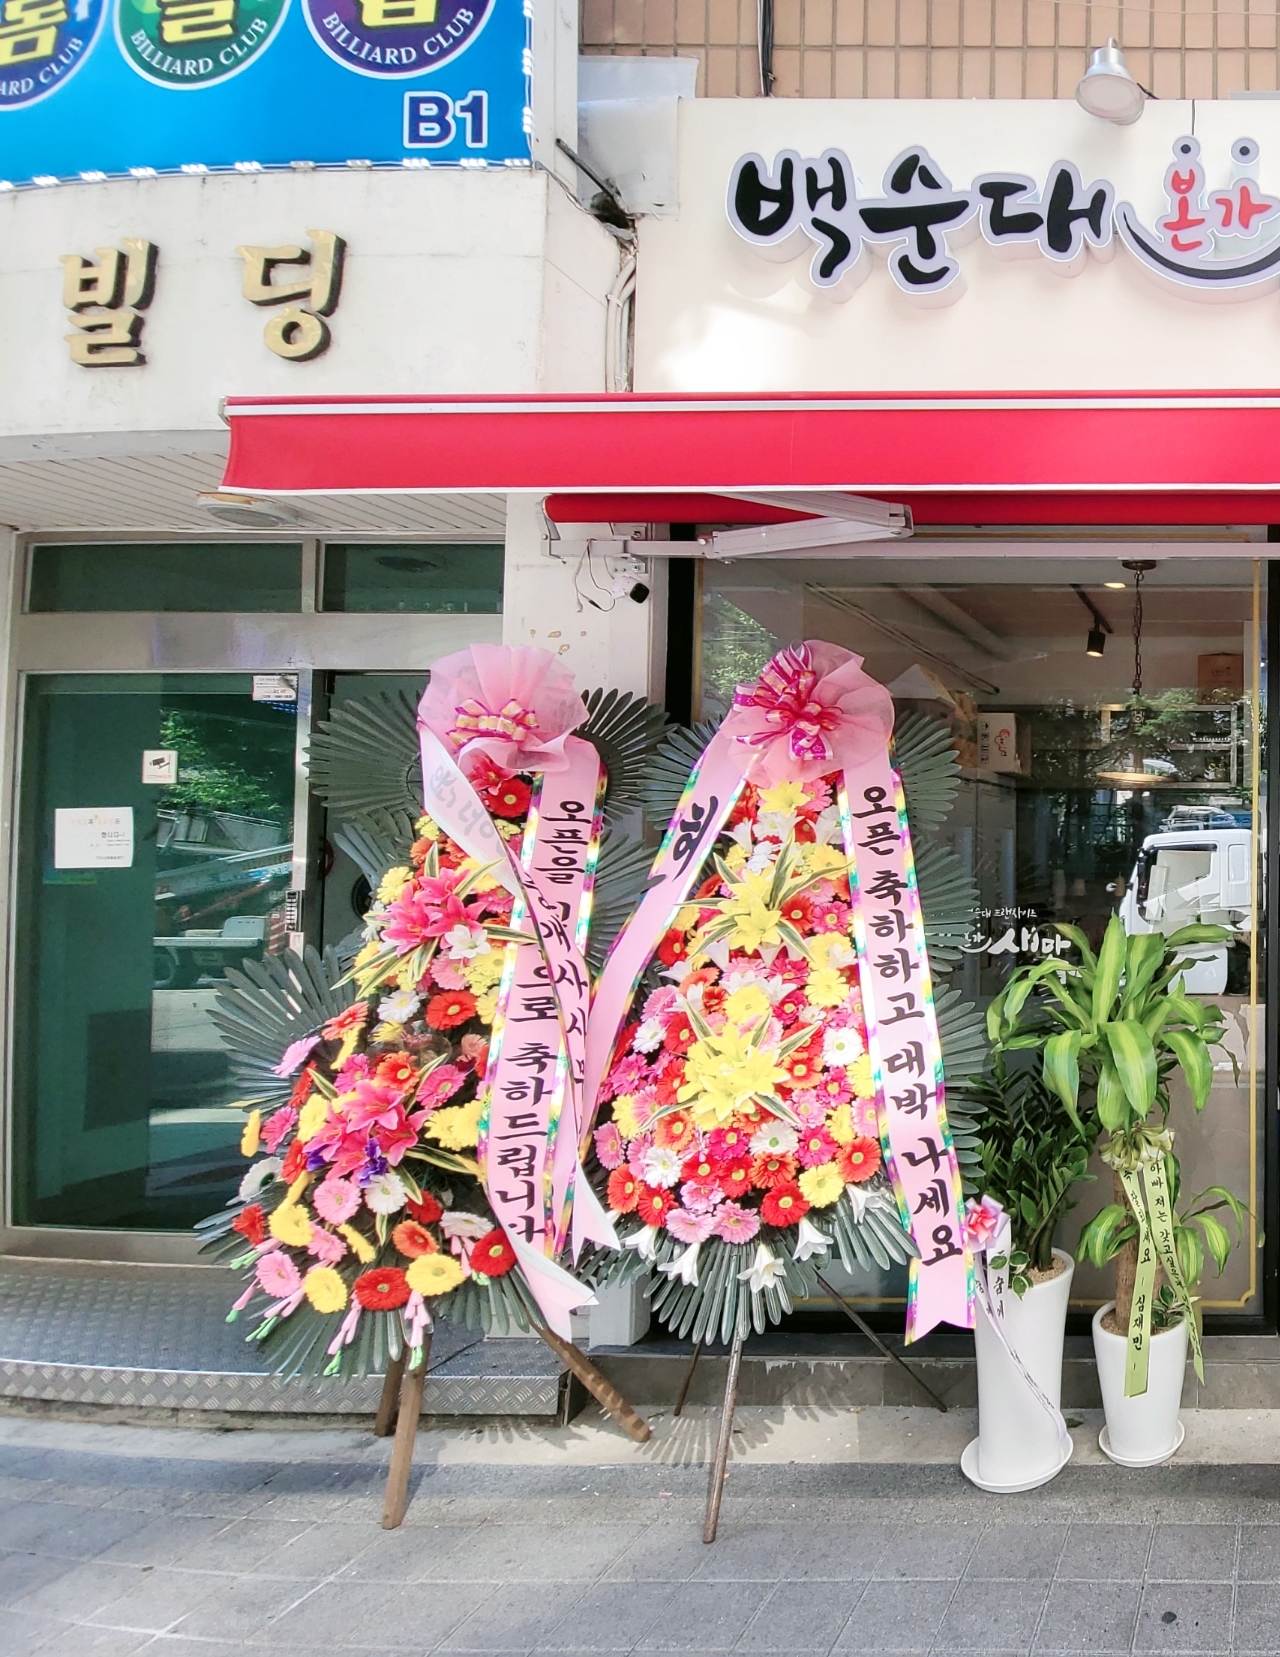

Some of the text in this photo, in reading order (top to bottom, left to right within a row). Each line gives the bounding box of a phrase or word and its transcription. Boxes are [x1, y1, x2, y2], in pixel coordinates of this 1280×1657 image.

[39, 37, 83, 84] CLUB
[131, 28, 213, 75] BILLIARD
[219, 18, 268, 65] CLUB
[322, 11, 416, 64] BILLIARD
[423, 8, 474, 55] CLUB
[404, 91, 487, 147] B1
[736, 152, 1106, 285] 백순대
[1162, 168, 1273, 253] 본가
[534, 800, 592, 885] 오픈을
[852, 786, 964, 1267] 오픈 축하하고 대박 나세요
